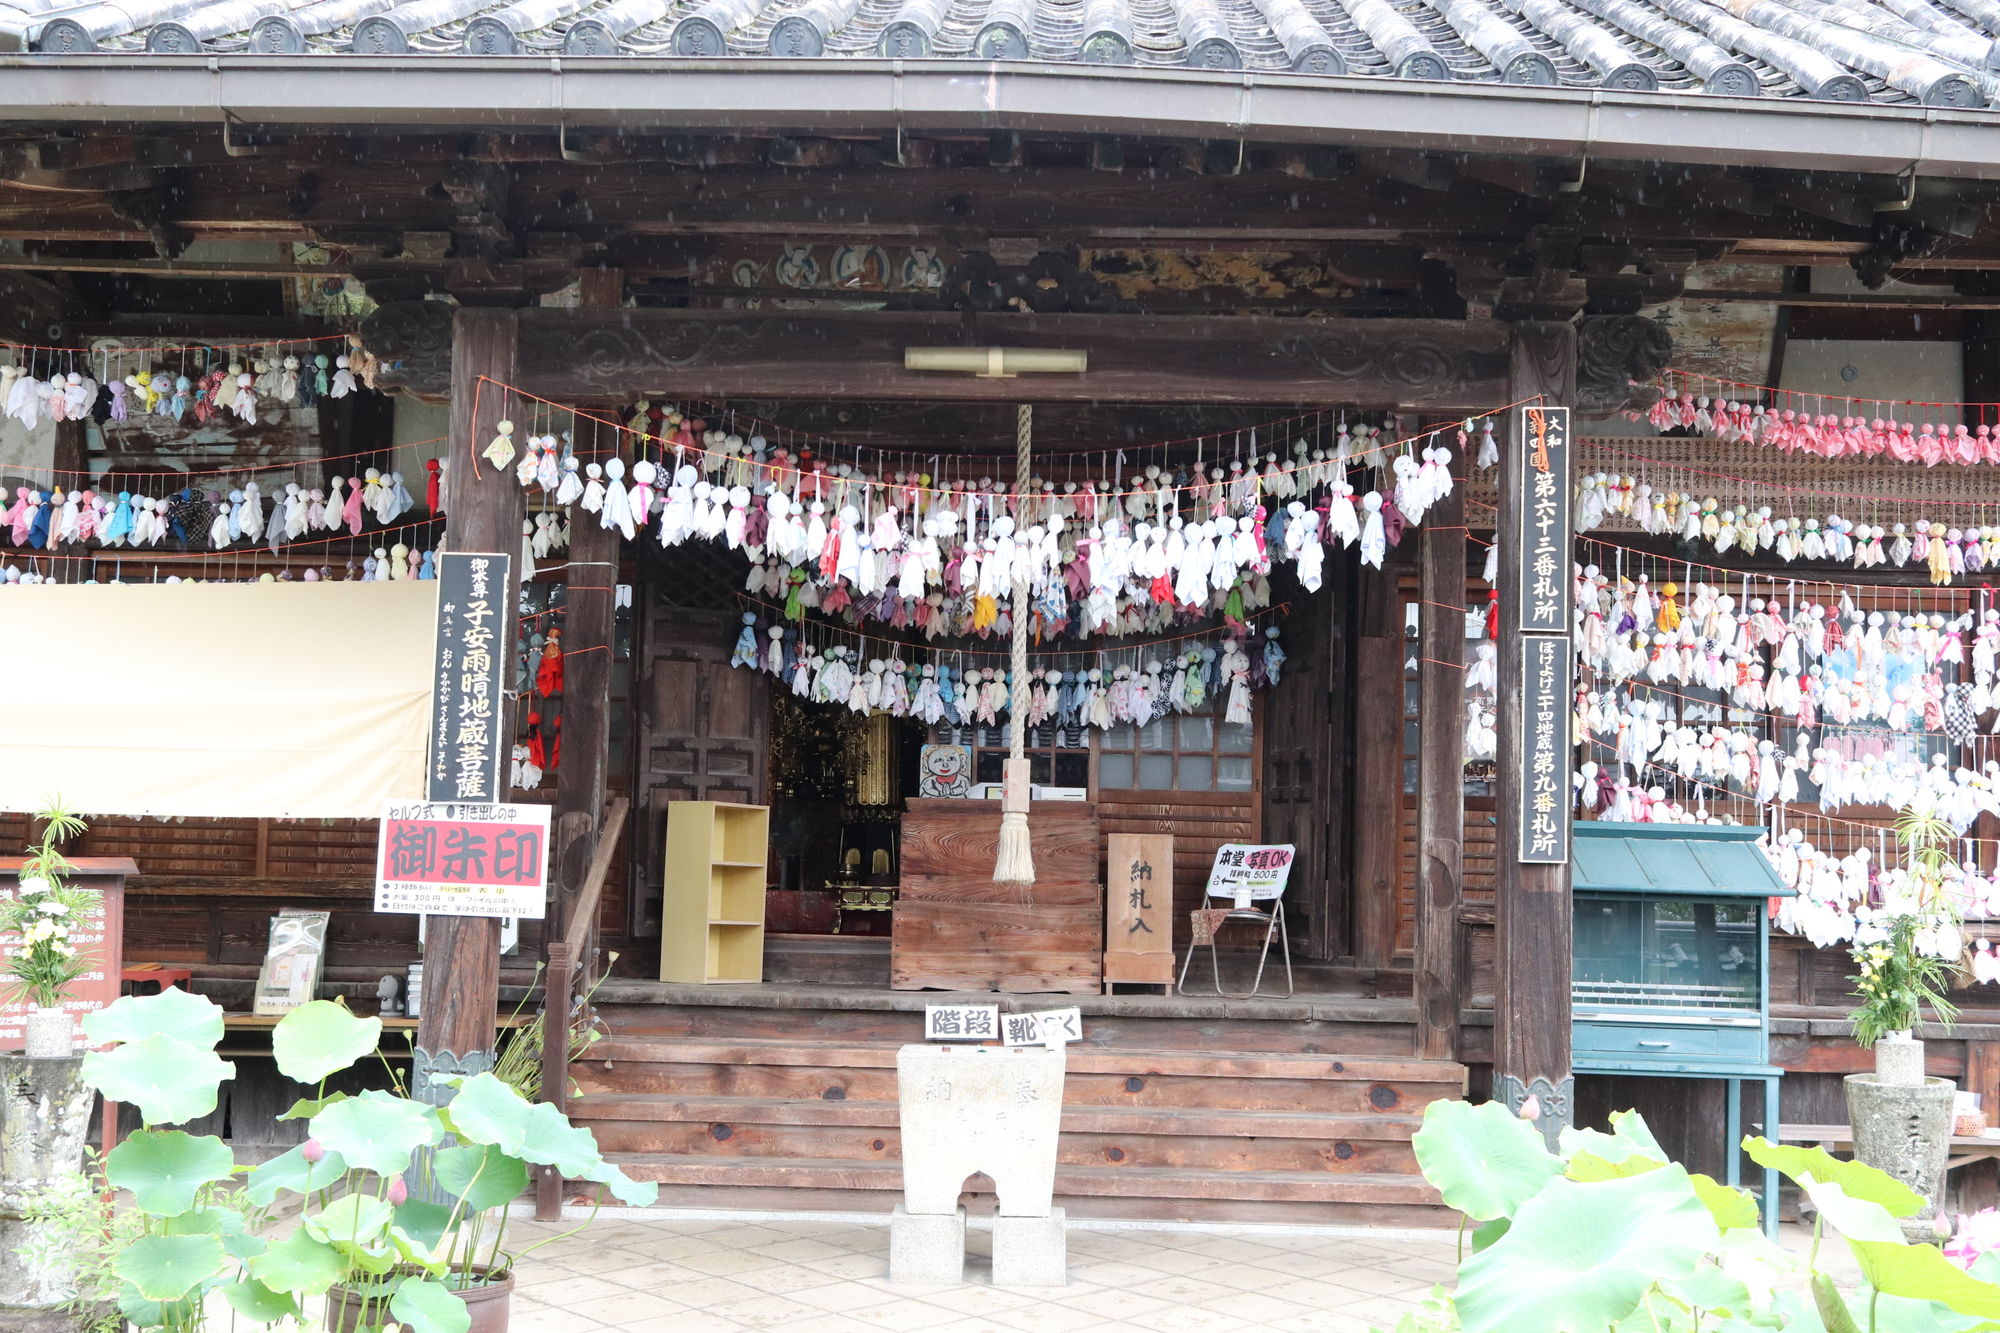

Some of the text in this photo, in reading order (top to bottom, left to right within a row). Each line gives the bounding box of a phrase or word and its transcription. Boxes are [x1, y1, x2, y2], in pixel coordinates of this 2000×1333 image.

[1546, 415, 1564, 449] 大和
[1531, 471, 1560, 625] 第六十三番札所
[389, 804, 435, 822] セルフ式
[459, 805, 517, 822] 引き出しの中
[390, 824, 538, 883] 御朱印
[1219, 849, 1245, 867] 本堂
[1128, 860, 1153, 935] 納札入
[931, 1009, 992, 1035] 階段
